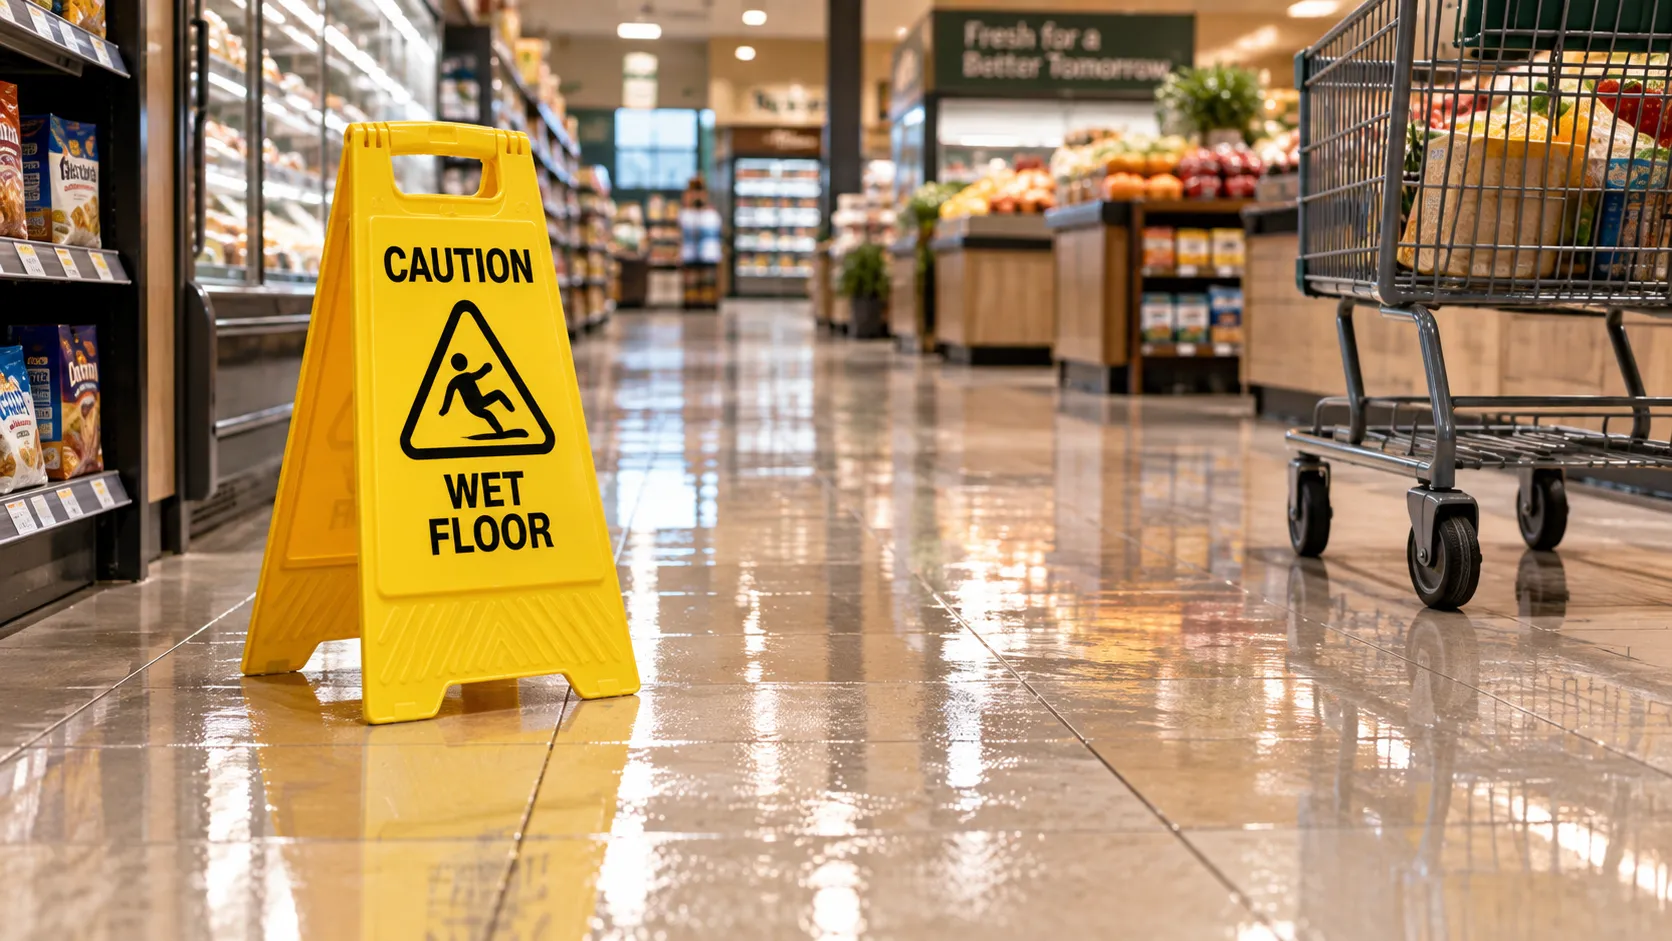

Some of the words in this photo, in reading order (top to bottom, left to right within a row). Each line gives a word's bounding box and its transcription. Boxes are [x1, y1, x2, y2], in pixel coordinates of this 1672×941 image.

[963, 20, 1037, 49] Fresh
[1040, 20, 1079, 50] for
[1082, 28, 1102, 51] a
[962, 50, 1042, 78] Better
[1047, 52, 1171, 80] Tomorrow
[383, 245, 534, 284] CAUTION
[443, 470, 524, 510] WET
[428, 512, 554, 556] FLOOR
